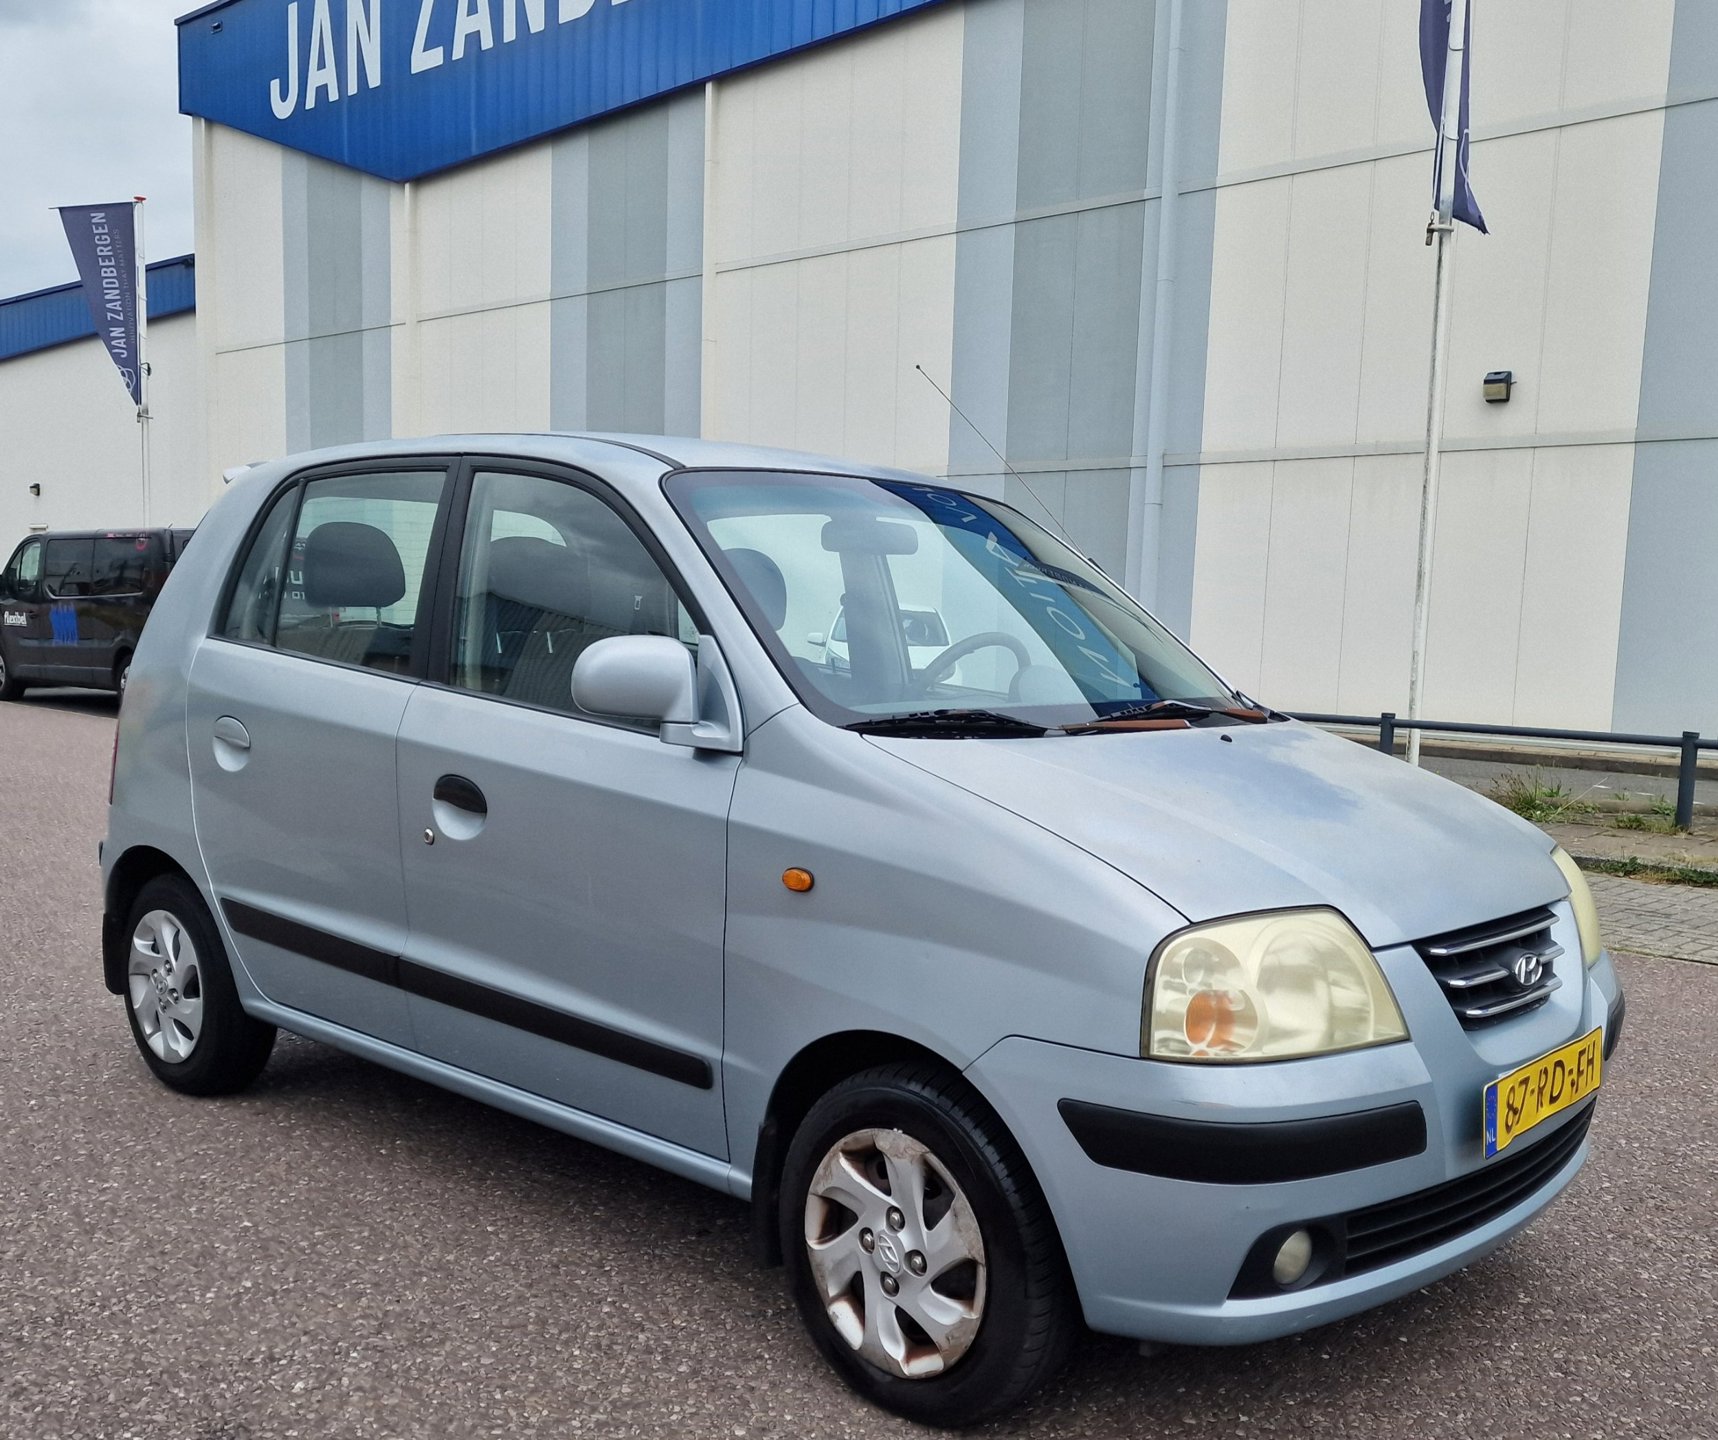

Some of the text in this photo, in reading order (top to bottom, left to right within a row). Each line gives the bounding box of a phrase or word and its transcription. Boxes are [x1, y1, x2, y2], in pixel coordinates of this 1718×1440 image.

[269, 0, 381, 120] JAN
[90, 212, 128, 358] JAN ZANDBERGEN
[1486, 1130, 1496, 1145] NL
[1504, 1039, 1596, 1134] 87-RD-FH
